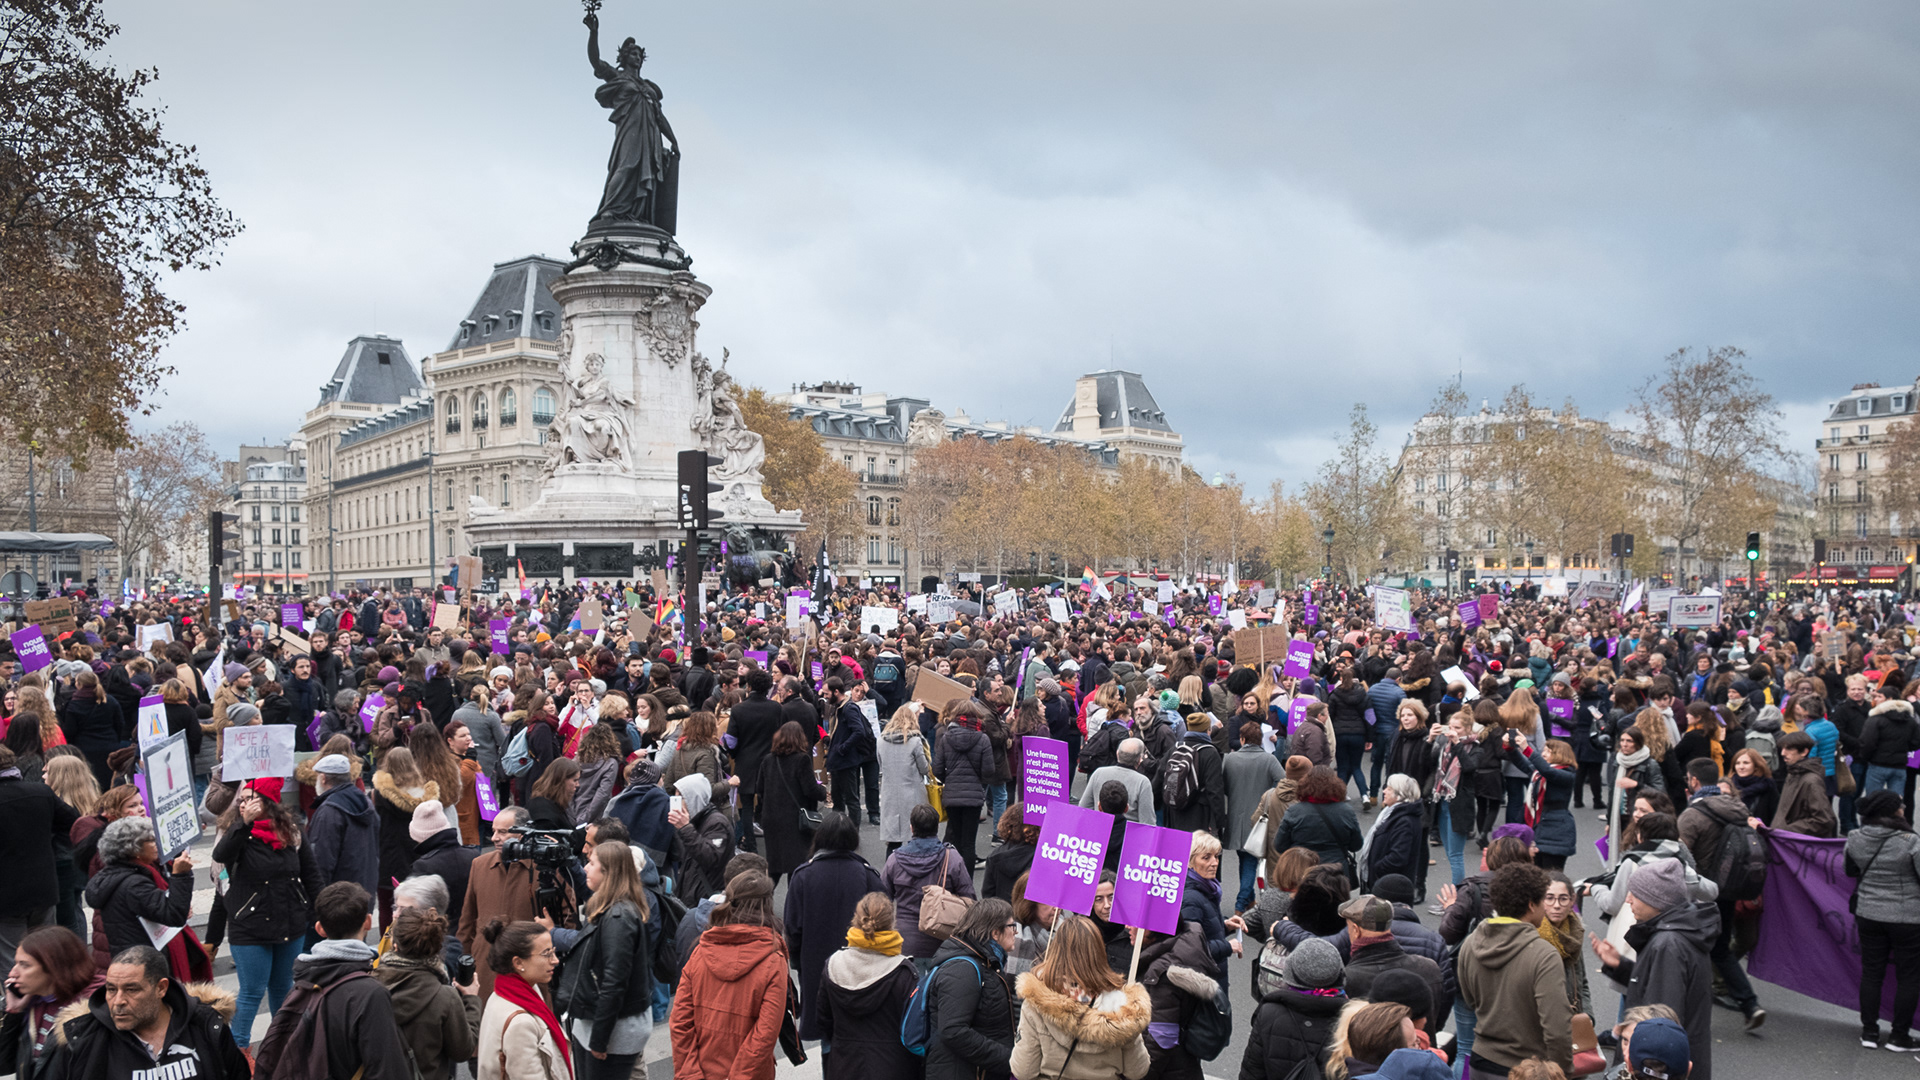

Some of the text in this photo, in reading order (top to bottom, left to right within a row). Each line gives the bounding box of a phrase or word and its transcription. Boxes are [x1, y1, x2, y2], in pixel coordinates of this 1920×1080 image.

[22, 636, 44, 648] nous
[20, 642, 46, 656] toutes
[1294, 650, 1311, 658] nous
[1289, 654, 1310, 664] toutes
[234, 732, 269, 746] METE A
[1040, 750, 1058, 760] femme
[1042, 760, 1059, 770] jamais
[1026, 768, 1060, 779] responsable
[1038, 778, 1062, 788] violences
[480, 791, 489, 800] le
[1026, 785, 1060, 797] qu'elle subit.
[483, 801, 497, 812] viol
[1026, 803, 1047, 814] JAMA
[170, 837, 182, 849] SIM
[1056, 833, 1102, 856] nous
[1041, 842, 1098, 870] toutes
[1138, 854, 1183, 874] nous
[1064, 866, 1095, 885] .org
[1124, 864, 1180, 889] toutes
[1147, 885, 1178, 904] .org
